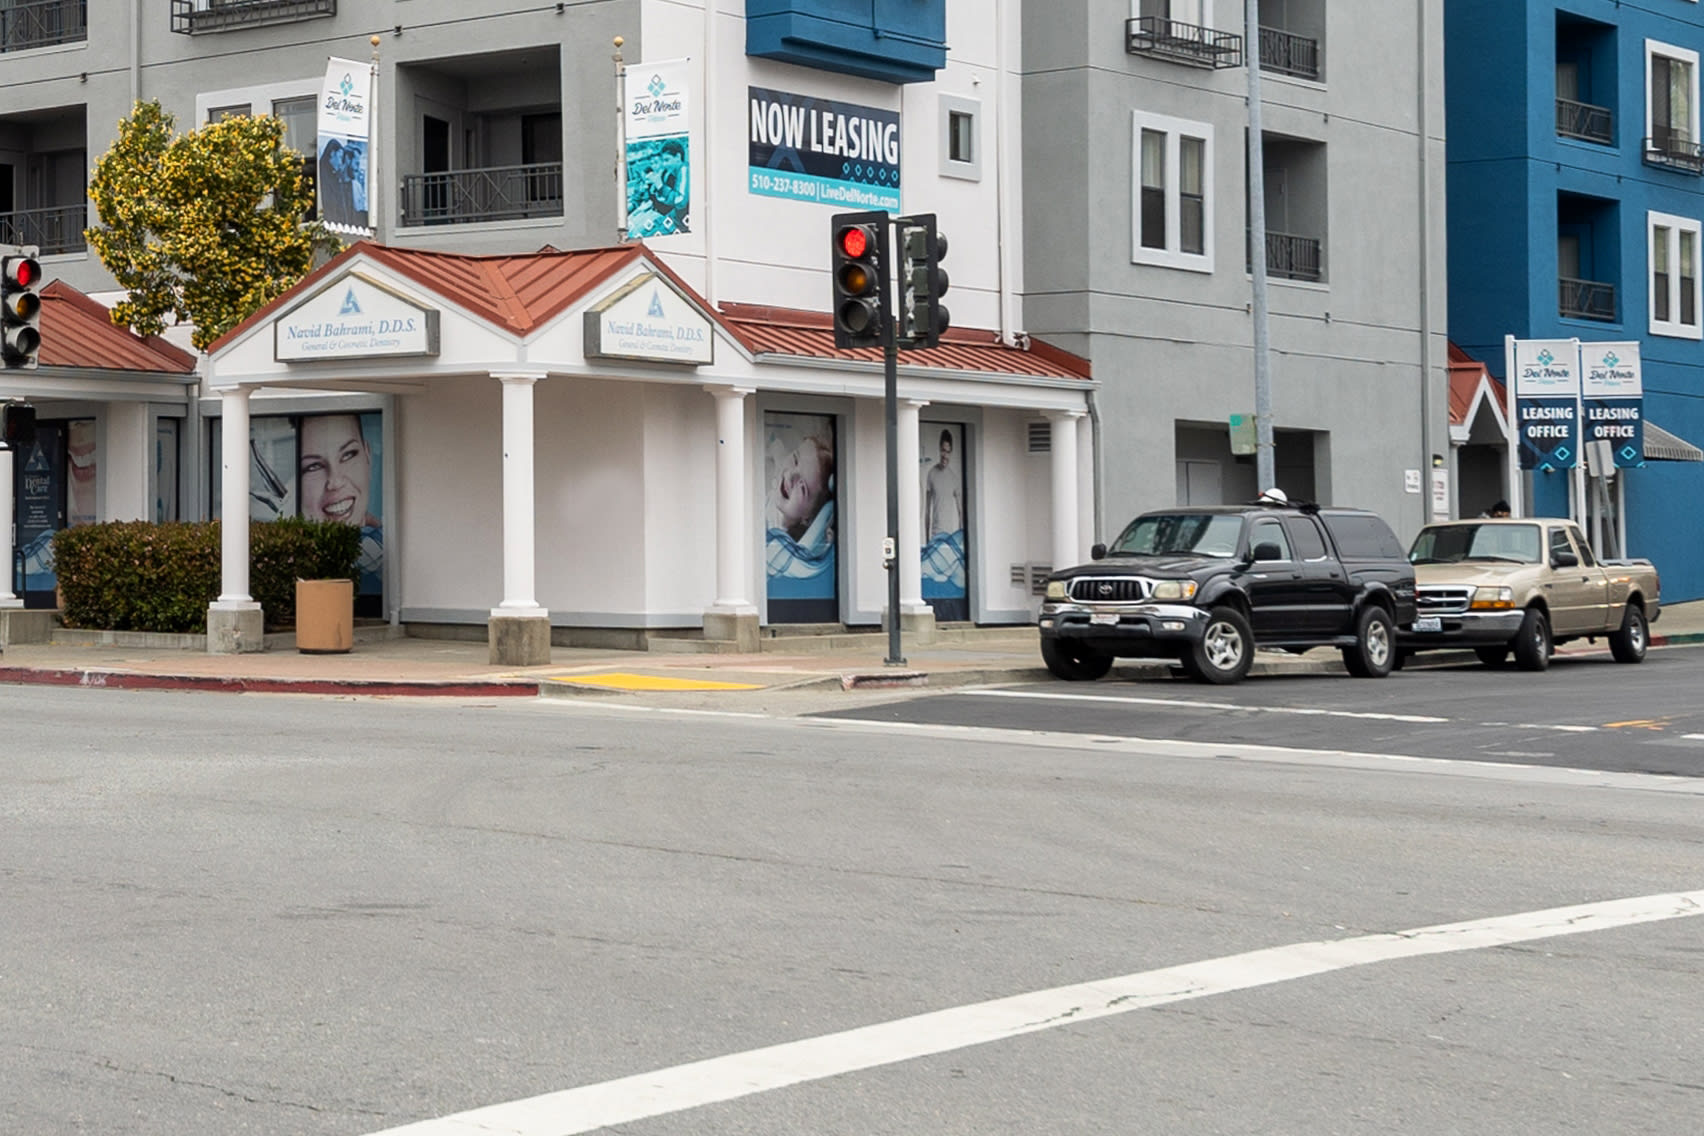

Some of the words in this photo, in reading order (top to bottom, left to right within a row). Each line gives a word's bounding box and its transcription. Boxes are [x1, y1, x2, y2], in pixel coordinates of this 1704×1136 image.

[632, 102, 652, 115] Del
[653, 99, 681, 113] Norte
[751, 98, 805, 150] NOW
[810, 109, 898, 165] LEASING
[752, 174, 815, 197] 510-237-8300
[821, 185, 898, 209] LiveDelNorte.com
[288, 324, 321, 339] Navid
[324, 321, 376, 338] Bahrami,
[378, 318, 417, 334] D.D.S.
[1522, 407, 1573, 419] LEASING
[1589, 407, 1639, 419] LEASING
[1527, 425, 1569, 438] OFFICE
[1594, 425, 1635, 438] OFFICE
